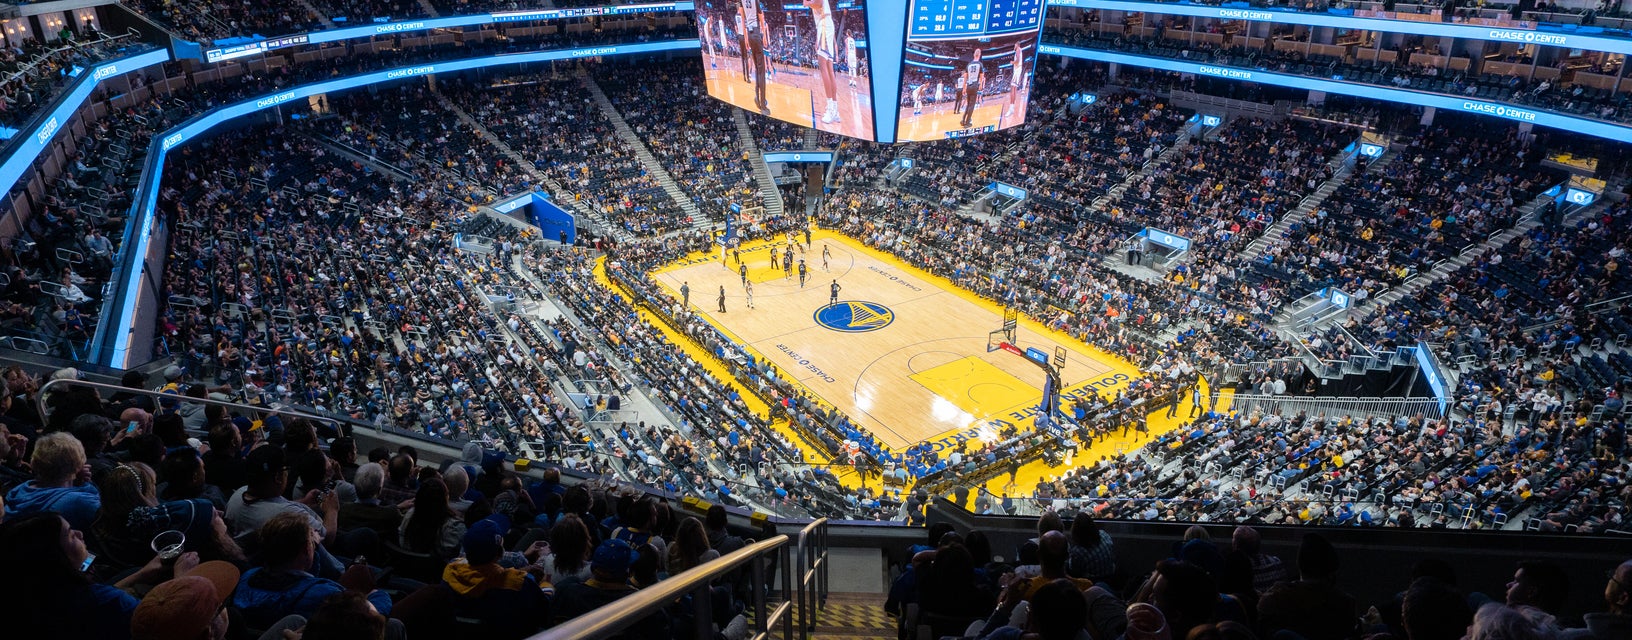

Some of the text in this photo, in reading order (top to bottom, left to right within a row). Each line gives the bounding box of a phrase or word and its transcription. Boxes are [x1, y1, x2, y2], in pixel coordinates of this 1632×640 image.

[1219, 9, 1273, 20] CHASE CENTER
[376, 24, 396, 32] CHASE
[1489, 30, 1567, 45] CHASE CENTER
[100, 65, 117, 77] CENTER
[387, 66, 434, 78] CHASE CENTER
[1199, 66, 1252, 79] CHASE CENTER
[257, 92, 295, 108] CHASE CENTER
[1463, 102, 1536, 121] CHASE CENTER
[896, 279, 922, 292] CHASE
[776, 343, 836, 383] CHASE CENTER
[1060, 373, 1130, 402] GOLDEN
